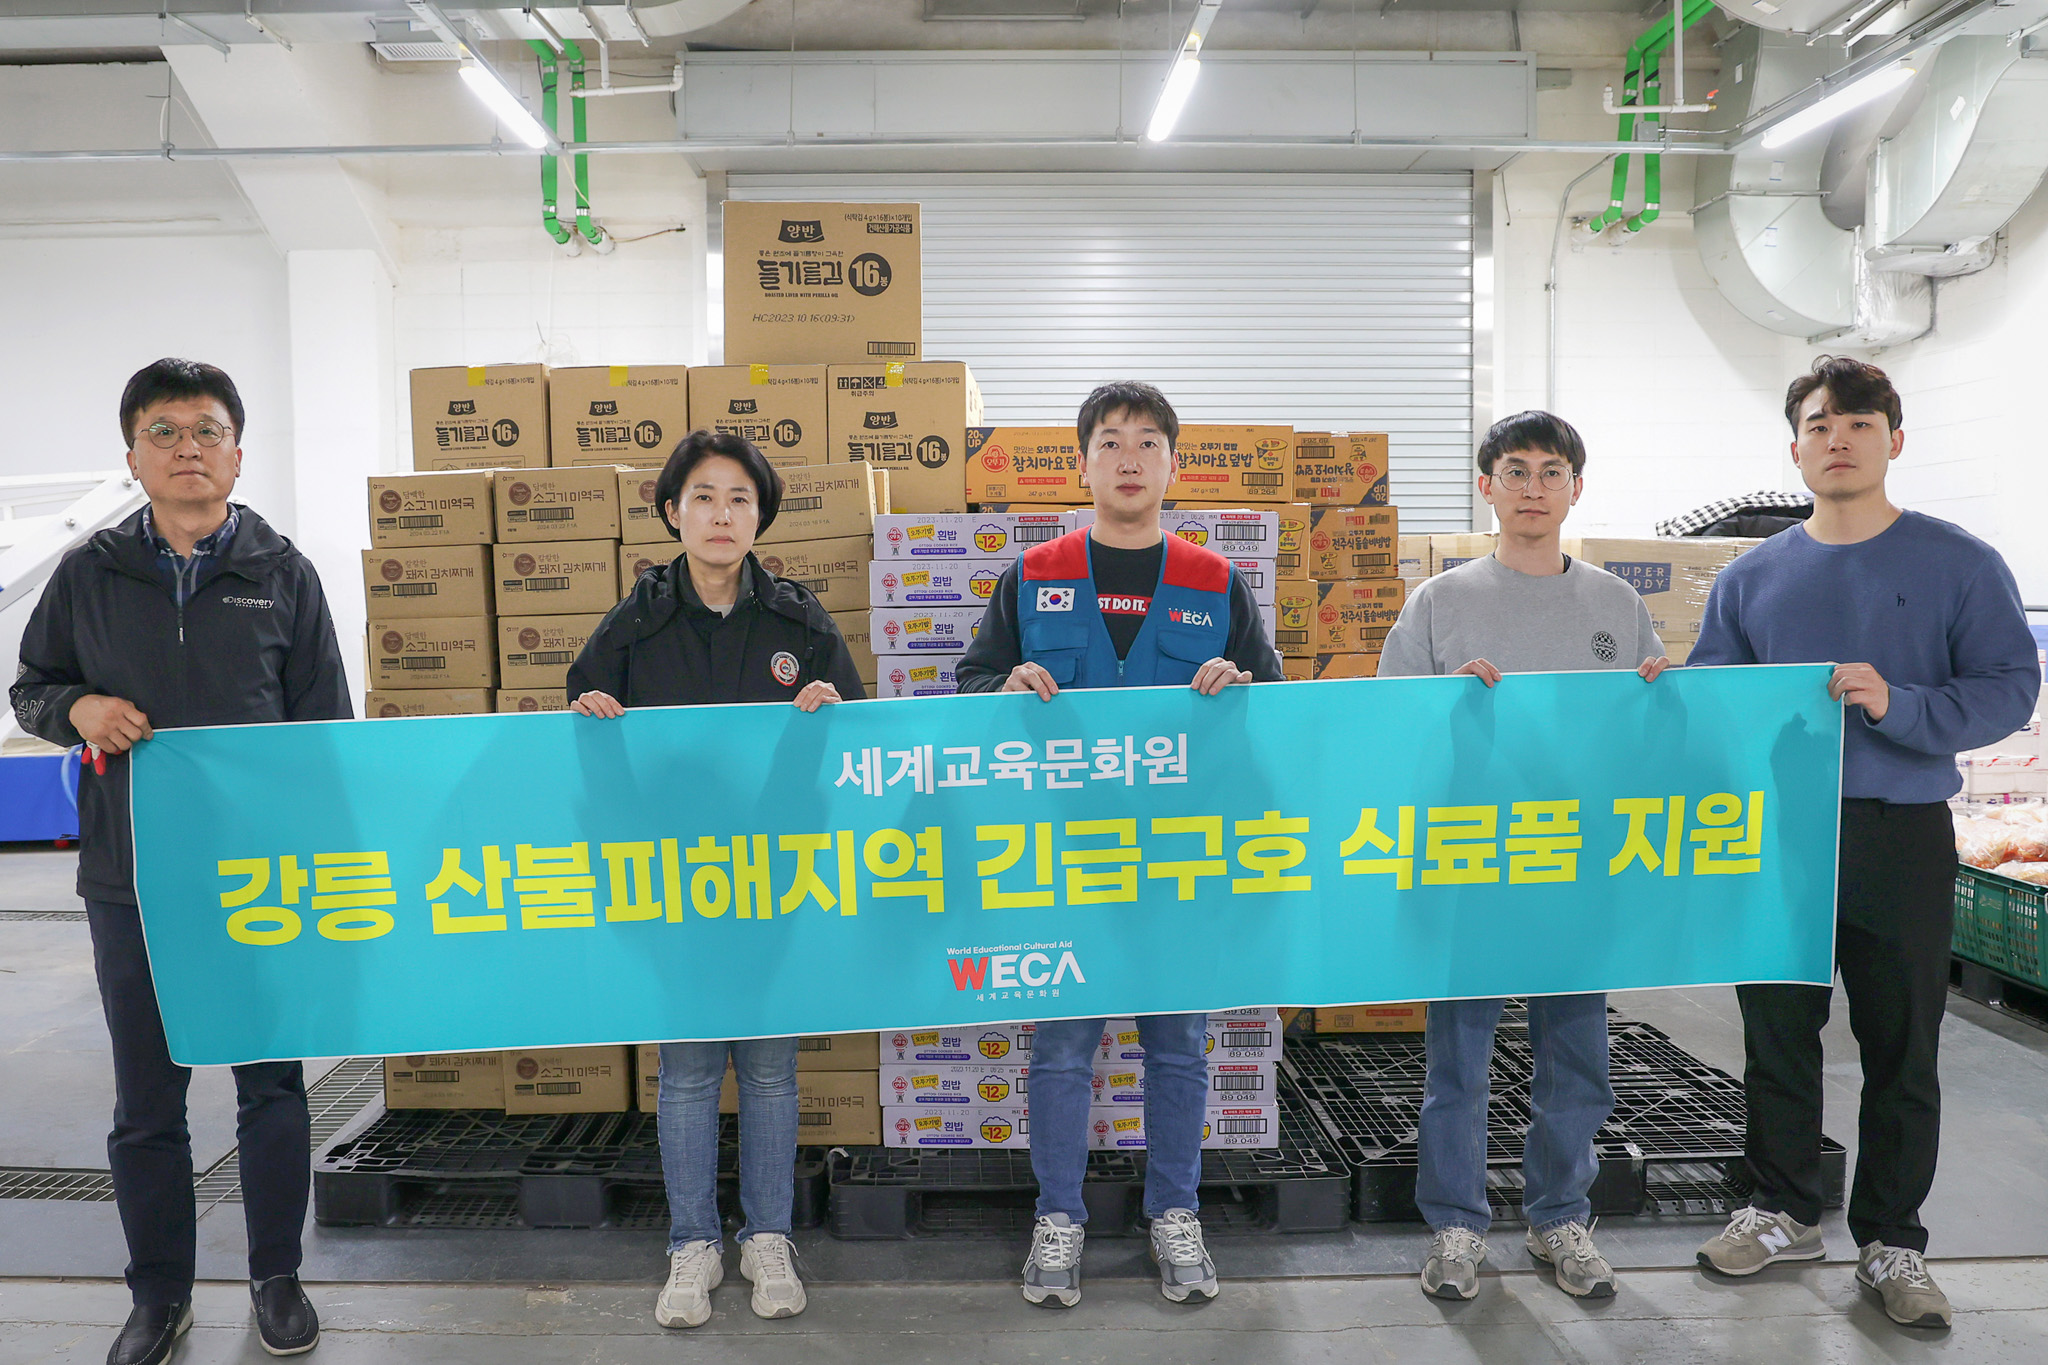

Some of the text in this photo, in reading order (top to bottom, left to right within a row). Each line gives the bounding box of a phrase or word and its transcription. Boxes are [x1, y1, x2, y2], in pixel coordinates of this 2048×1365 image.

[787, 224, 815, 239] 양반
[757, 260, 844, 290] 들기름김
[870, 414, 892, 426] 양반
[436, 425, 489, 446] 들기름김
[576, 426, 632, 447] 들기름김
[968, 440, 982, 448] UP
[1036, 446, 1058, 454] 오뚜기
[1200, 442, 1221, 450] 오뚜기
[1012, 456, 1077, 472] 참치마요덮
[790, 478, 860, 494] 돼지 김치찌개
[1374, 484, 1386, 493] UP
[936, 530, 958, 540] 흰밥
[982, 535, 996, 549] 12
[406, 567, 474, 580] 돼지 김치찌개
[538, 562, 607, 575] 돼지 김치찌개
[1611, 566, 1665, 577] SUPER
[932, 576, 952, 587] 흰밥
[1633, 578, 1664, 590] DDY
[978, 582, 992, 594] 12
[1112, 598, 1131, 610] DO
[1168, 610, 1214, 627] WECA
[934, 623, 954, 634] 흰밥
[543, 636, 565, 649] 돼지
[834, 732, 1188, 797] 세계교육문화원
[218, 790, 1766, 946] 강릉 산불피해지역 긴급구호 식료품 지원
[947, 940, 1072, 955] World Educational Cultural Aid
[948, 950, 1086, 991] WECA
[942, 1036, 961, 1048] 흰밥
[986, 1042, 1000, 1055] 12
[1229, 1050, 1242, 1058] 89
[942, 1080, 961, 1090] 흰밥
[985, 1086, 1000, 1098] 12
[944, 1121, 964, 1132] 흰밥
[988, 1127, 1002, 1140] 12
